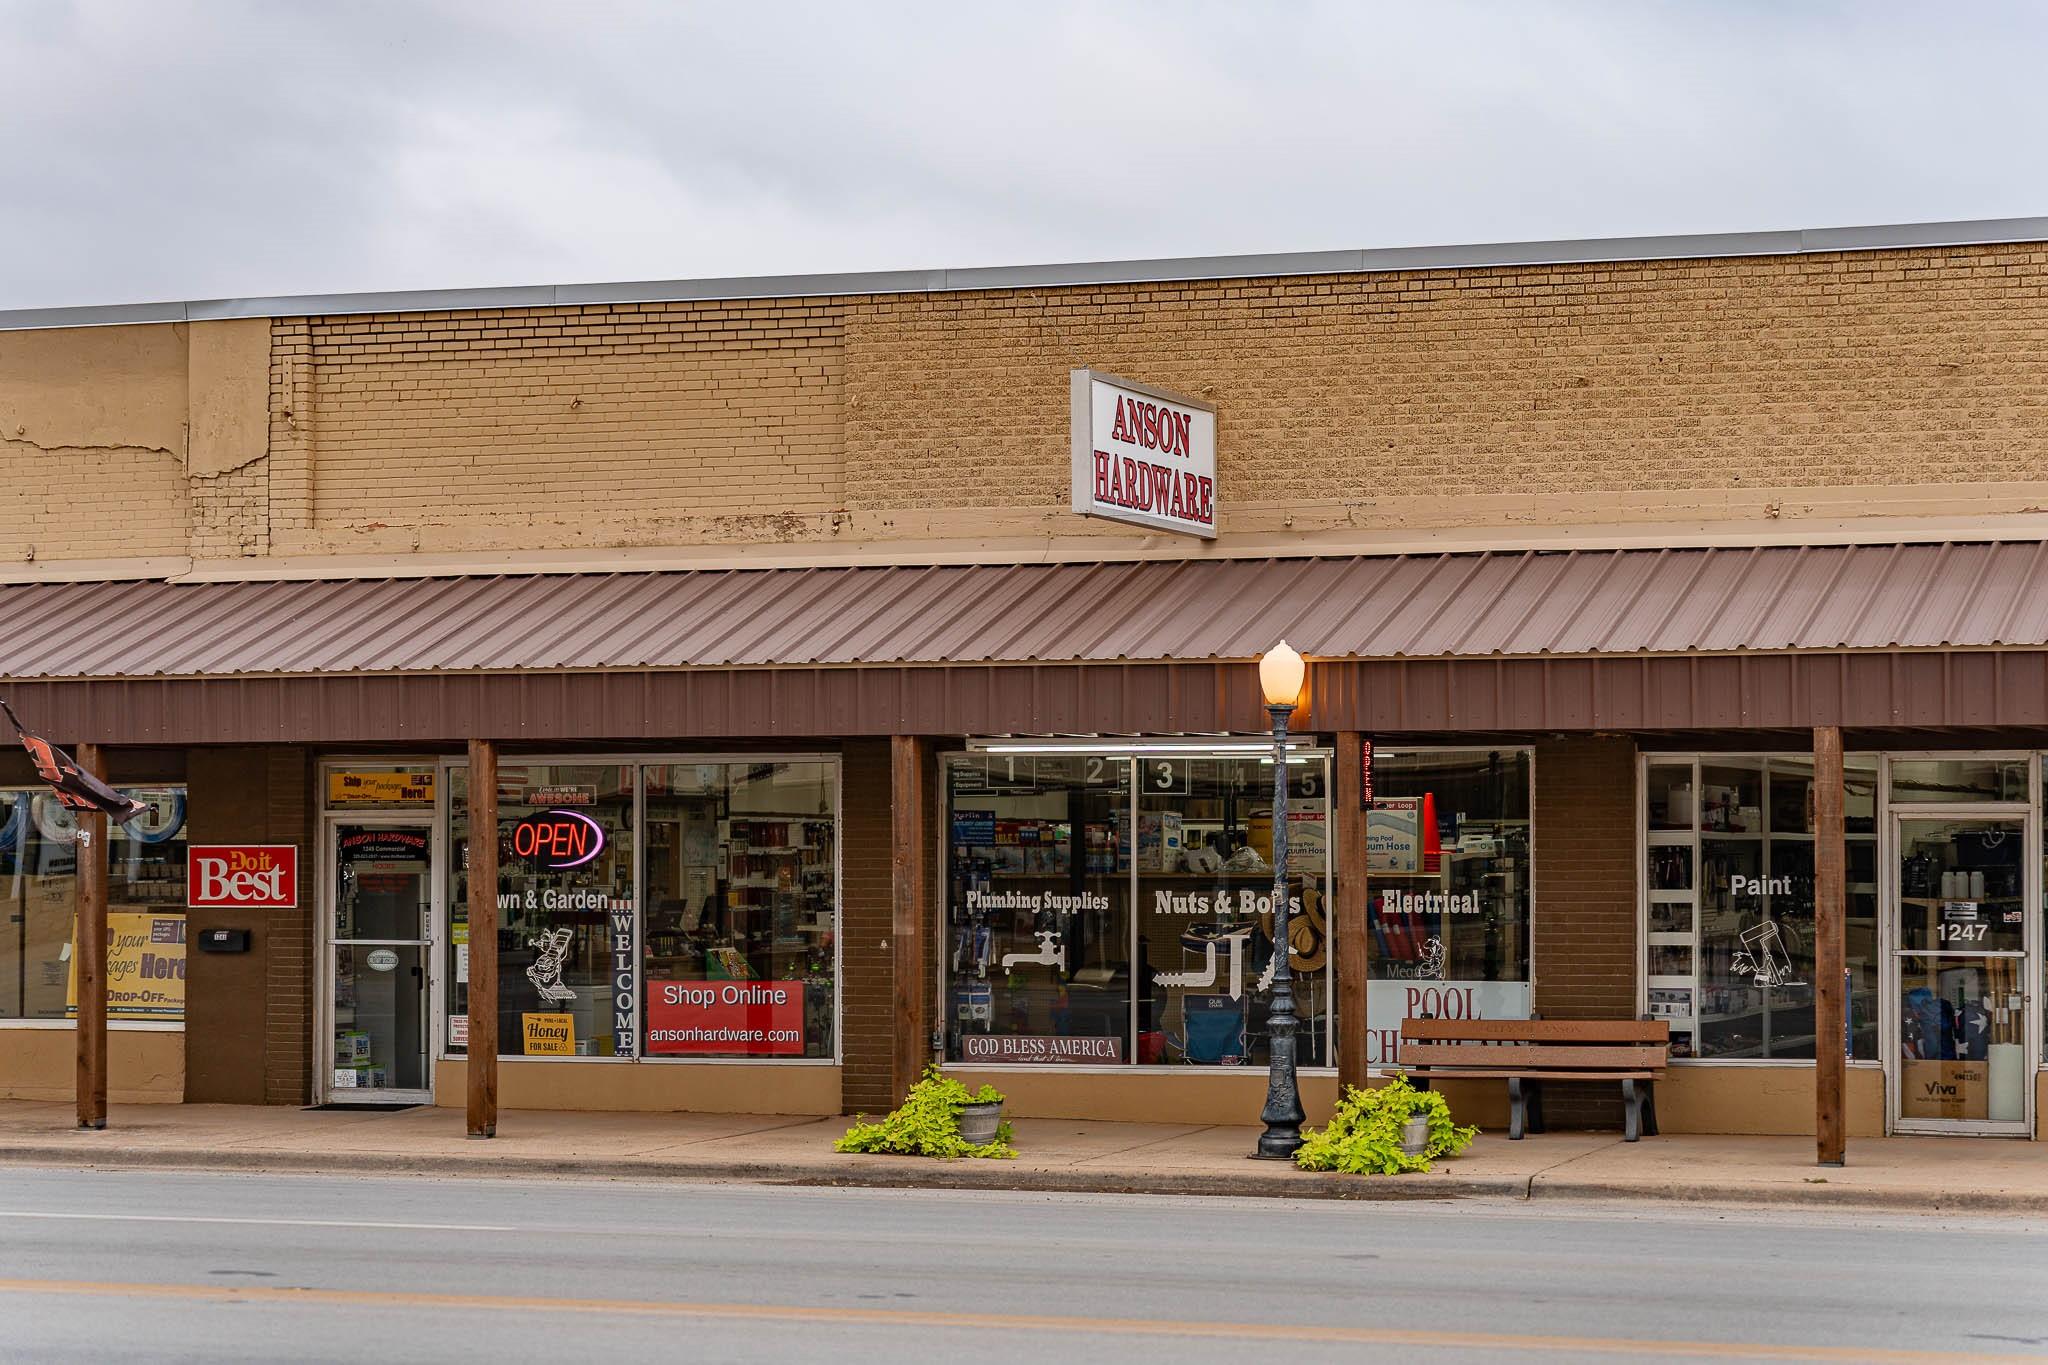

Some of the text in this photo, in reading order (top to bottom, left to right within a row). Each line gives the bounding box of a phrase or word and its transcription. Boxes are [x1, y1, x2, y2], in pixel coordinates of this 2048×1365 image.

[1112, 395, 1191, 458] ANSON
[1094, 450, 1212, 524] HARDWARE
[344, 776, 362, 787] Ship
[1005, 757, 1014, 782] 1
[1087, 757, 1103, 784] 2
[1156, 762, 1173, 788] 3
[1301, 772, 1316, 796] 5
[528, 793, 590, 804] AWESOME
[515, 823, 587, 856] OPEN
[229, 850, 272, 870] Do it
[197, 858, 286, 900] Best
[1731, 874, 1791, 896] Paint
[526, 889, 538, 909] &
[543, 889, 608, 909] Garden
[966, 890, 1109, 914] Plumbing Supplies
[1155, 890, 1301, 914] Nuts & Bols
[1382, 889, 1480, 914] Electrical
[1936, 923, 1988, 941] 1247
[117, 935, 148, 956] your
[613, 915, 633, 1049] WELCOME
[664, 985, 787, 1009] Shop Online
[1405, 987, 1482, 1020] POOL
[527, 1023, 568, 1042] Honey
[650, 1027, 799, 1042] ansonhardware.com
[530, 1043, 558, 1051] FOR SALE
[968, 1038, 1116, 1057] GOD BLESS AMERICA
[1925, 1081, 1956, 1095] Viva
